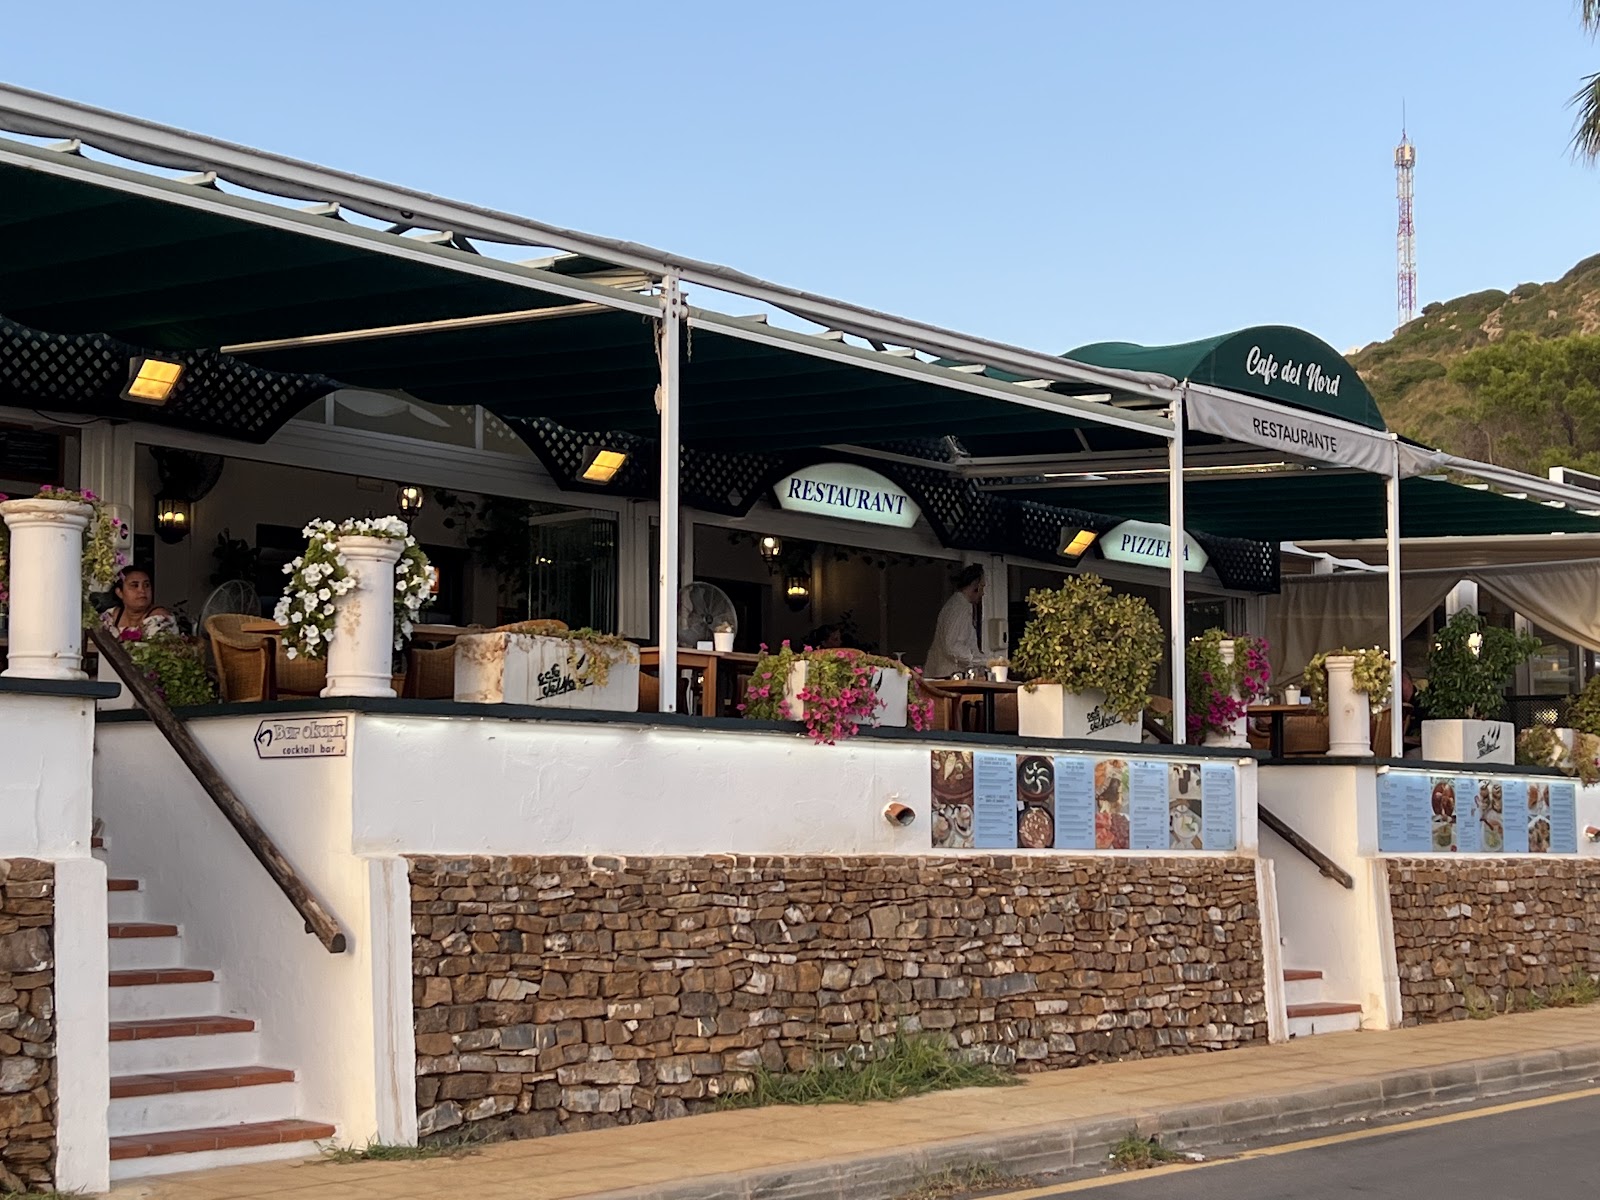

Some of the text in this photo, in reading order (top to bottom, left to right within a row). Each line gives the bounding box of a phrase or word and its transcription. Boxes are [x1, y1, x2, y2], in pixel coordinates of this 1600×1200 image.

[1246, 345, 1341, 397] Cafe del Nord
[1252, 417, 1337, 453] RESTAURANTE
[787, 477, 907, 515] RESTAURANT
[273, 724, 301, 741] Bar
[282, 743, 336, 755] cocktail bar
